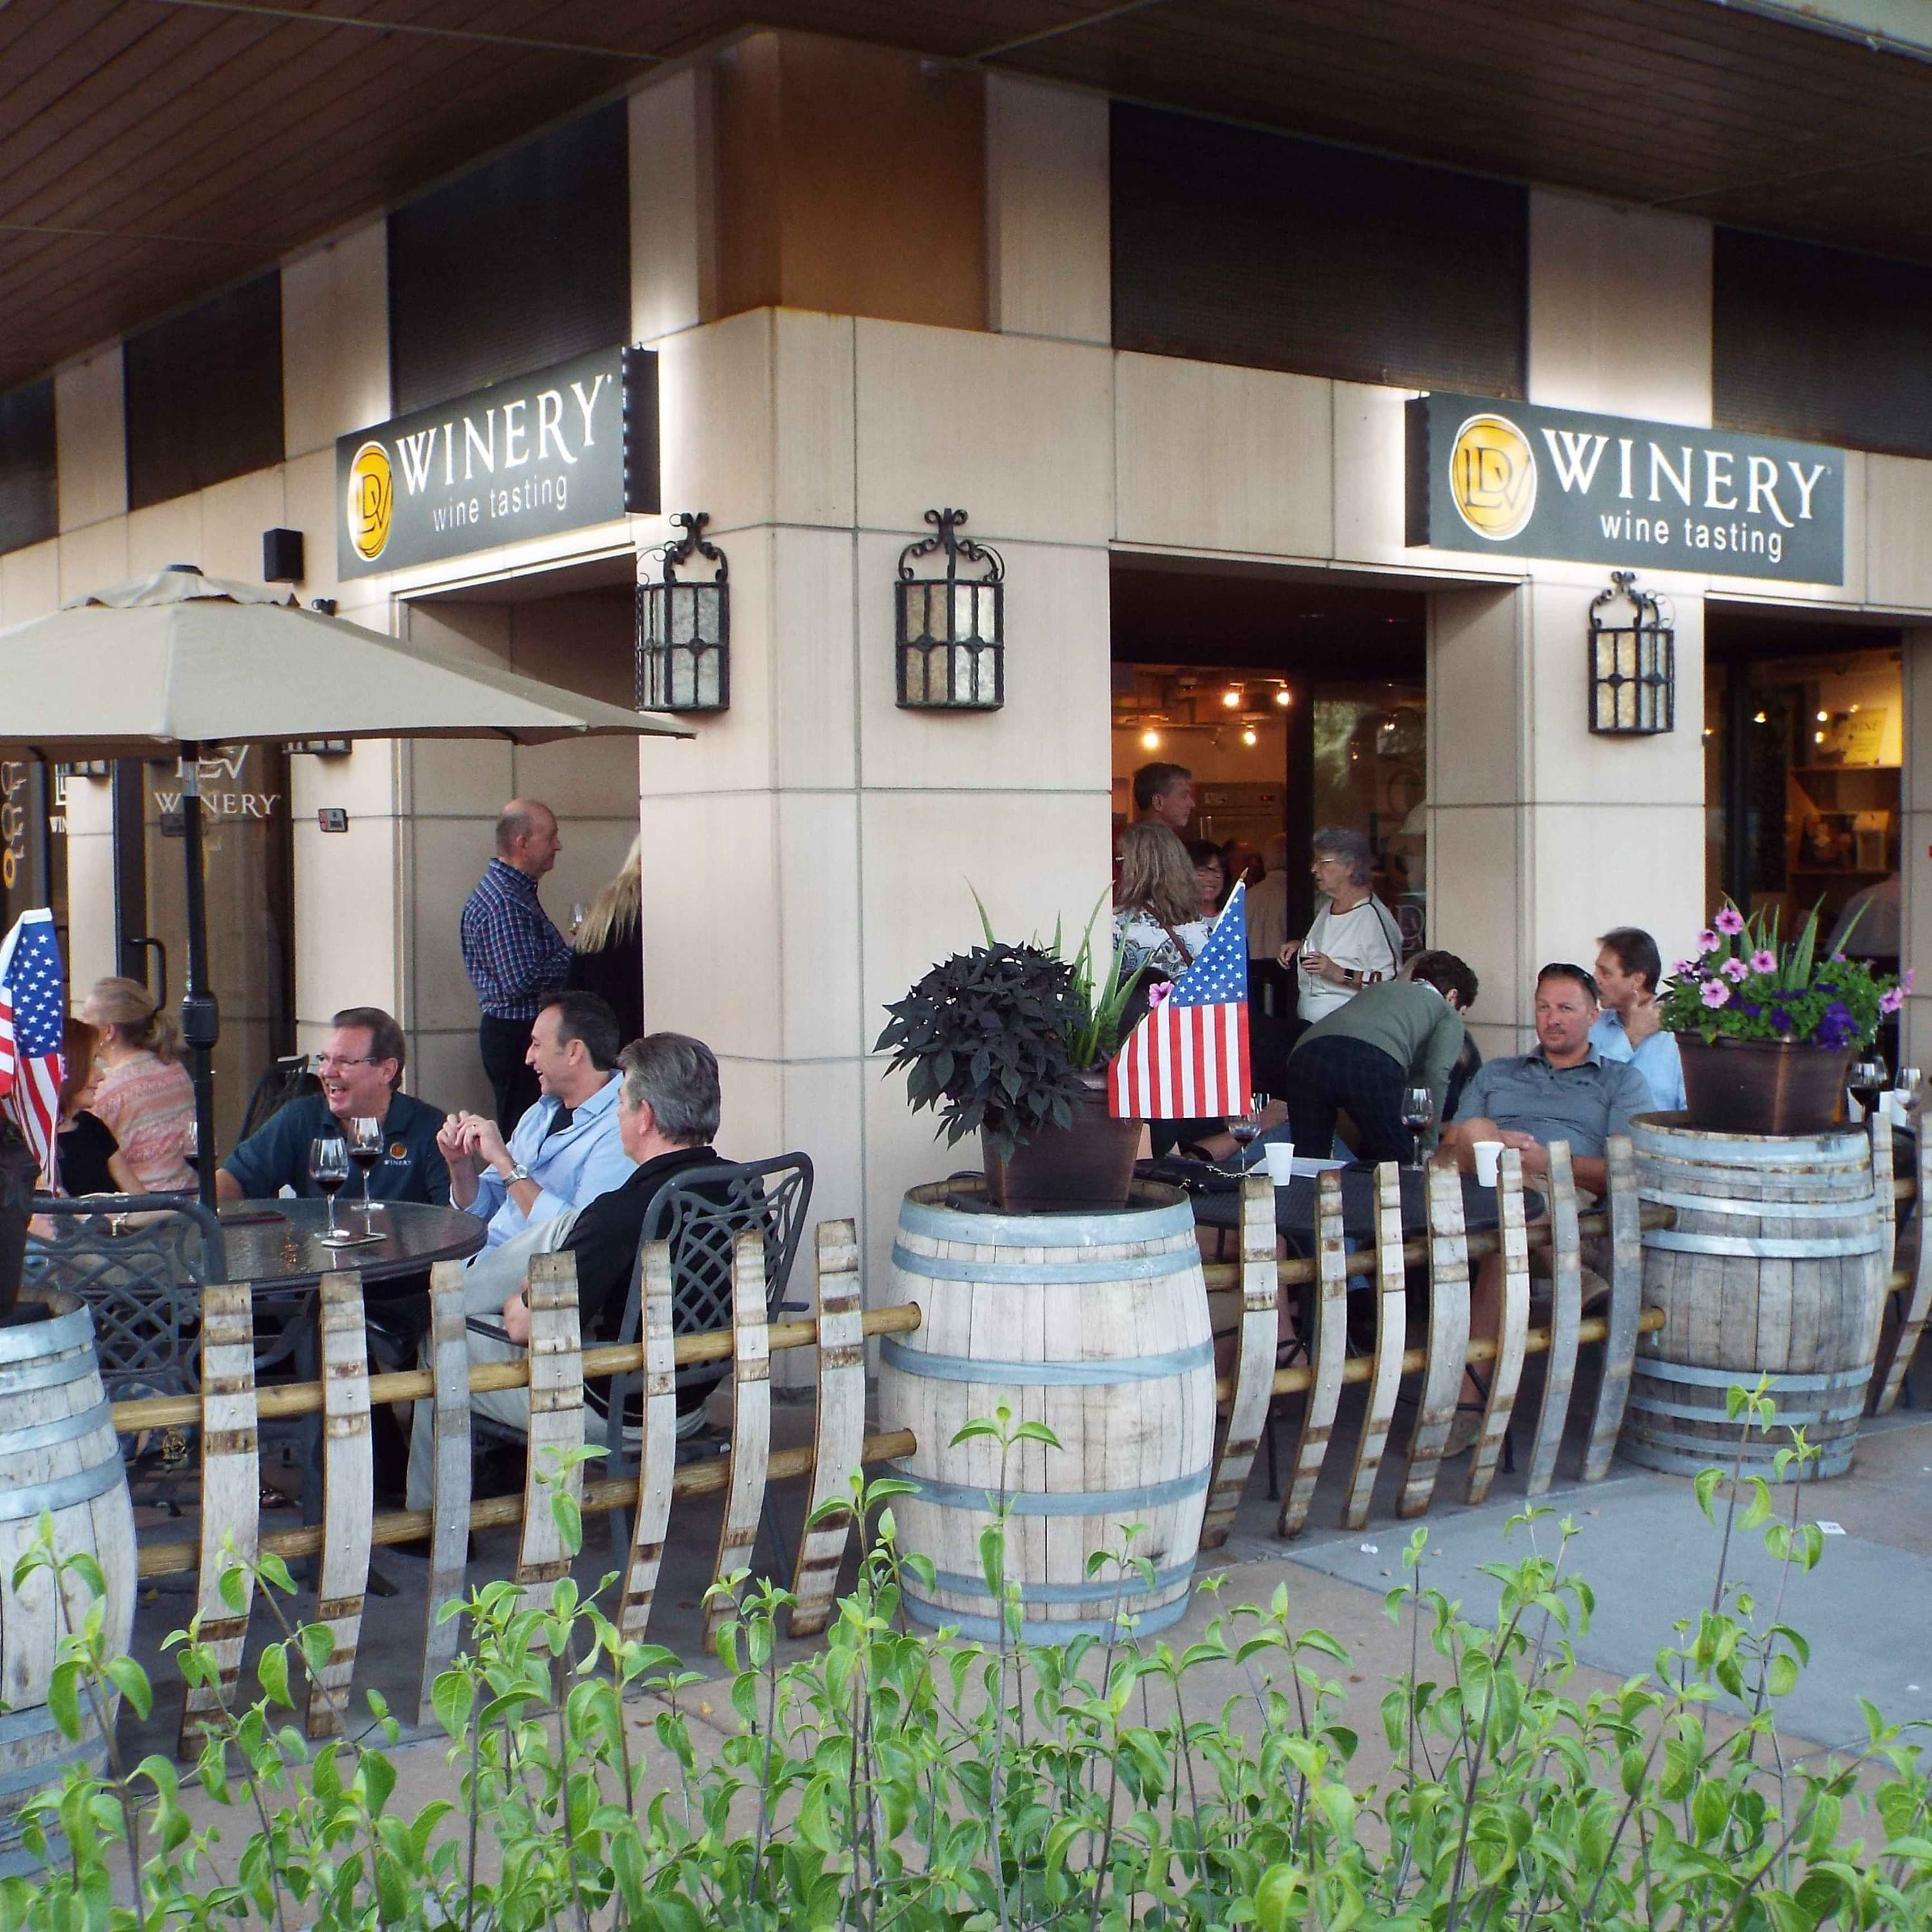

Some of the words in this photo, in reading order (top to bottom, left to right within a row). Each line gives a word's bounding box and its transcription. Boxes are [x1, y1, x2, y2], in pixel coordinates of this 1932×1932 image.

[395, 374, 604, 496] WINERY
[433, 497, 480, 532] wine
[489, 475, 567, 511] tasting
[1540, 428, 1826, 528] WINERY
[1600, 509, 1670, 545] wine
[1683, 518, 1783, 564] tasting
[154, 793, 276, 818] WNERY
